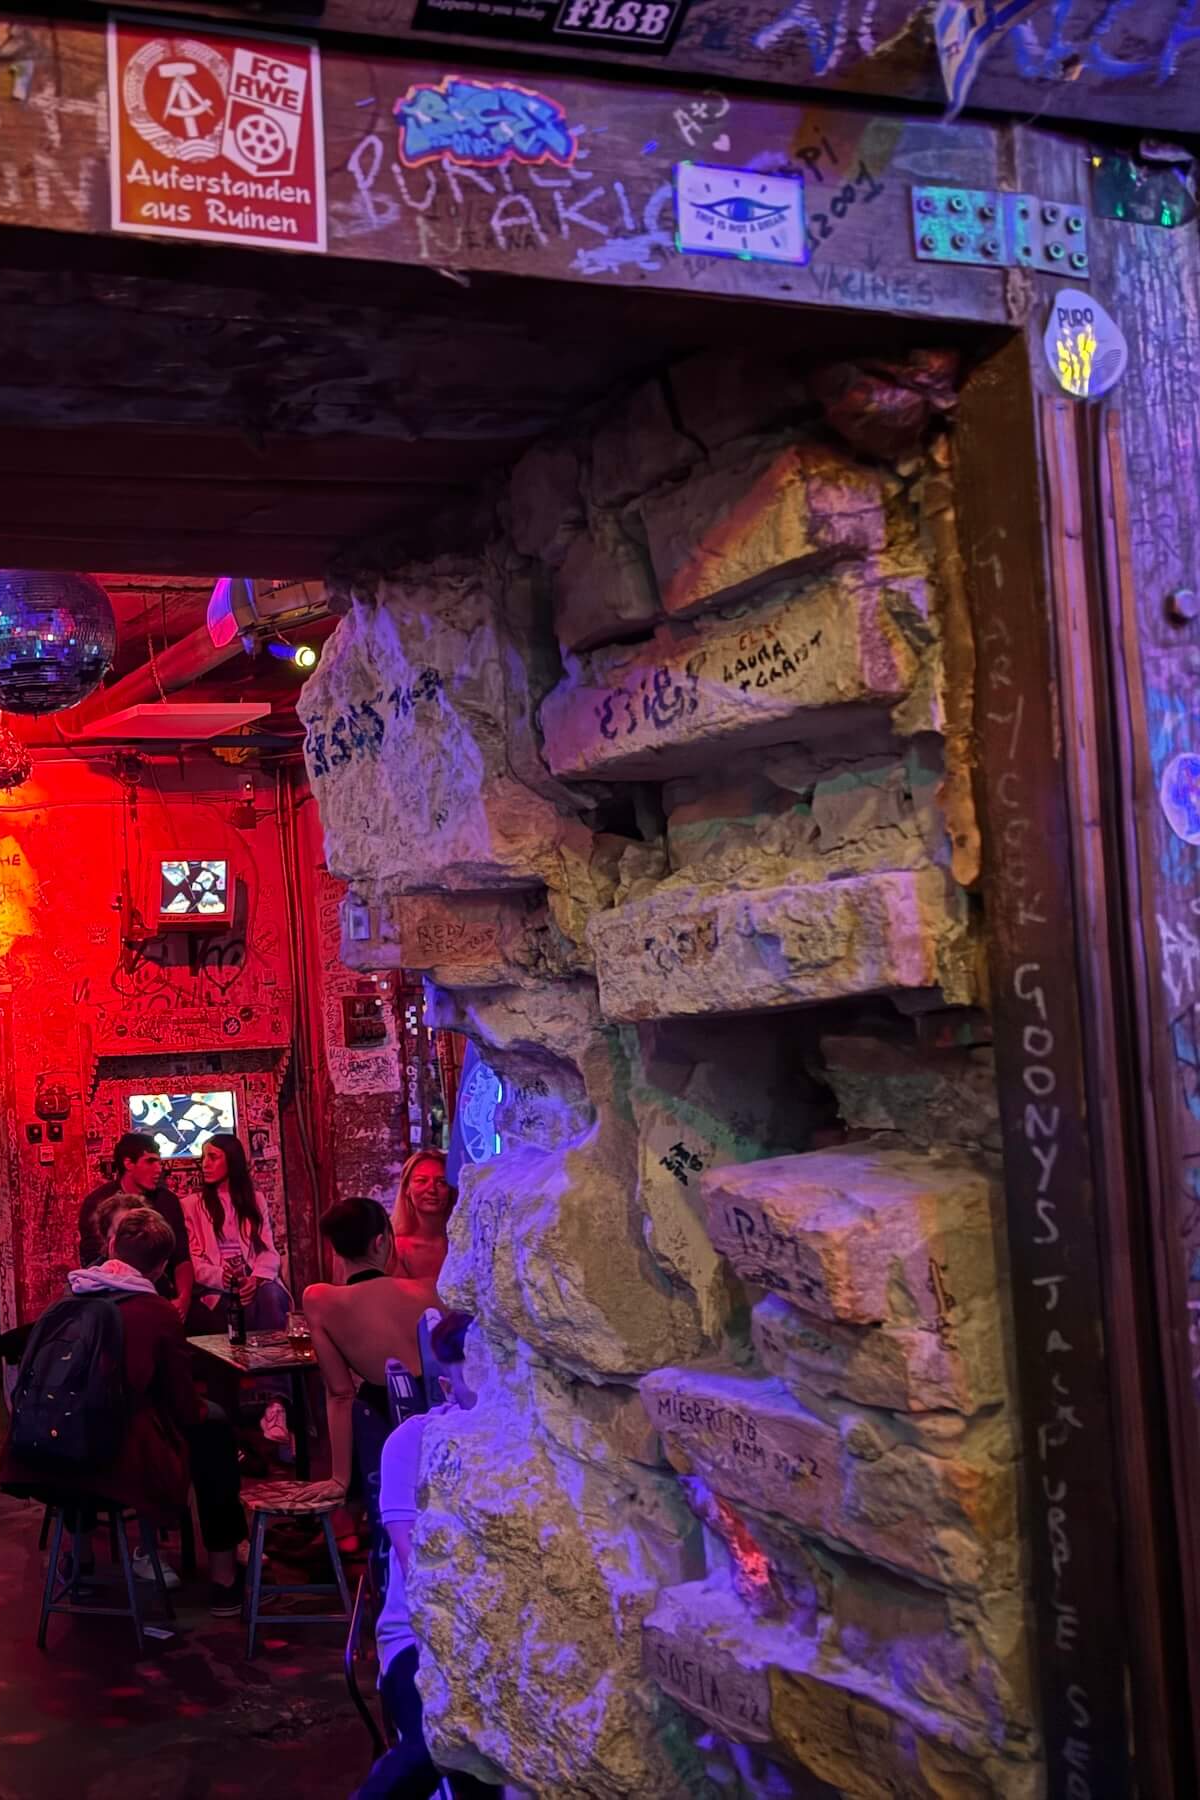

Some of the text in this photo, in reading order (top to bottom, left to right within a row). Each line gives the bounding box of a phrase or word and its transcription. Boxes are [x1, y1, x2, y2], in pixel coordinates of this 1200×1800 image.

[562, 0, 671, 36] FLSB
[250, 56, 289, 85] FC
[233, 72, 301, 111] RWE
[126, 159, 311, 205] Auferstanden
[140, 198, 299, 234] aus Ruinen
[1057, 307, 1094, 329] PURO
